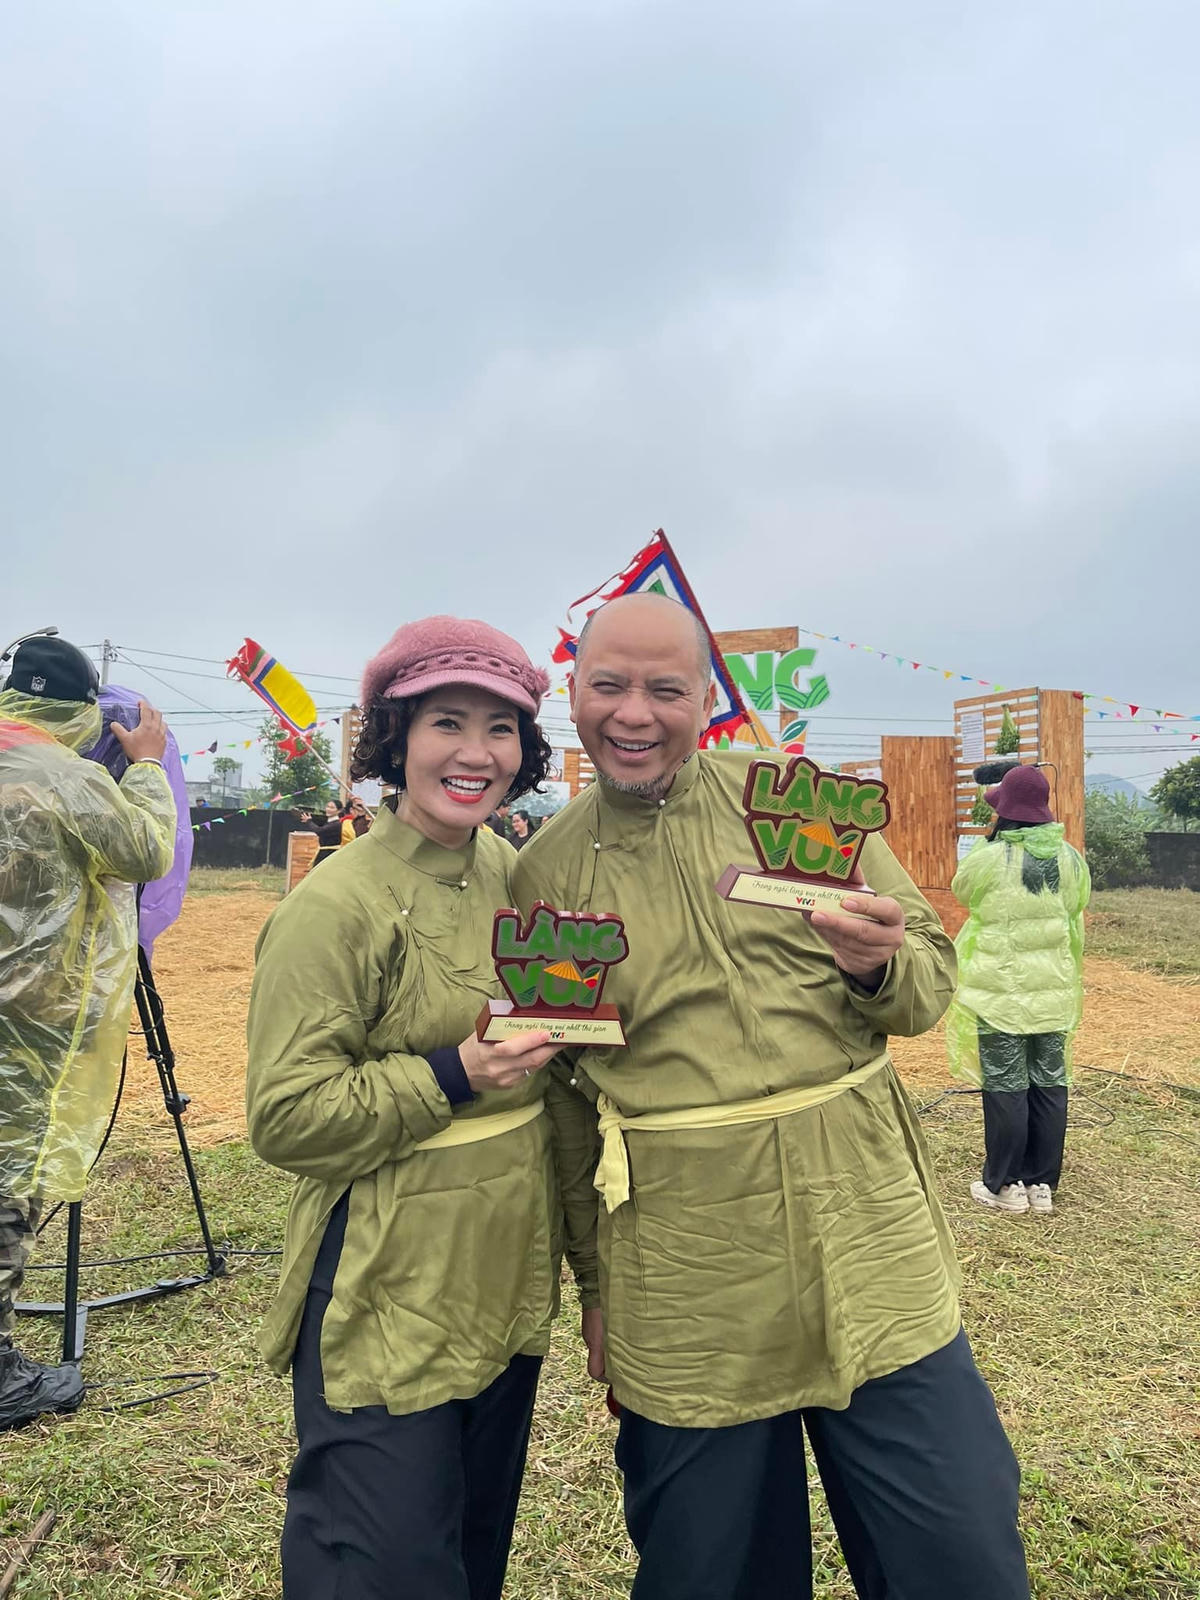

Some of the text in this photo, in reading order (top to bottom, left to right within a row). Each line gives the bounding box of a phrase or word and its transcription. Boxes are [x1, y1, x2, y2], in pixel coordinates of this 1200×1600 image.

[722, 648, 830, 711] NG
[753, 763, 885, 830] LÀNG
[498, 911, 624, 961] LÀNG
